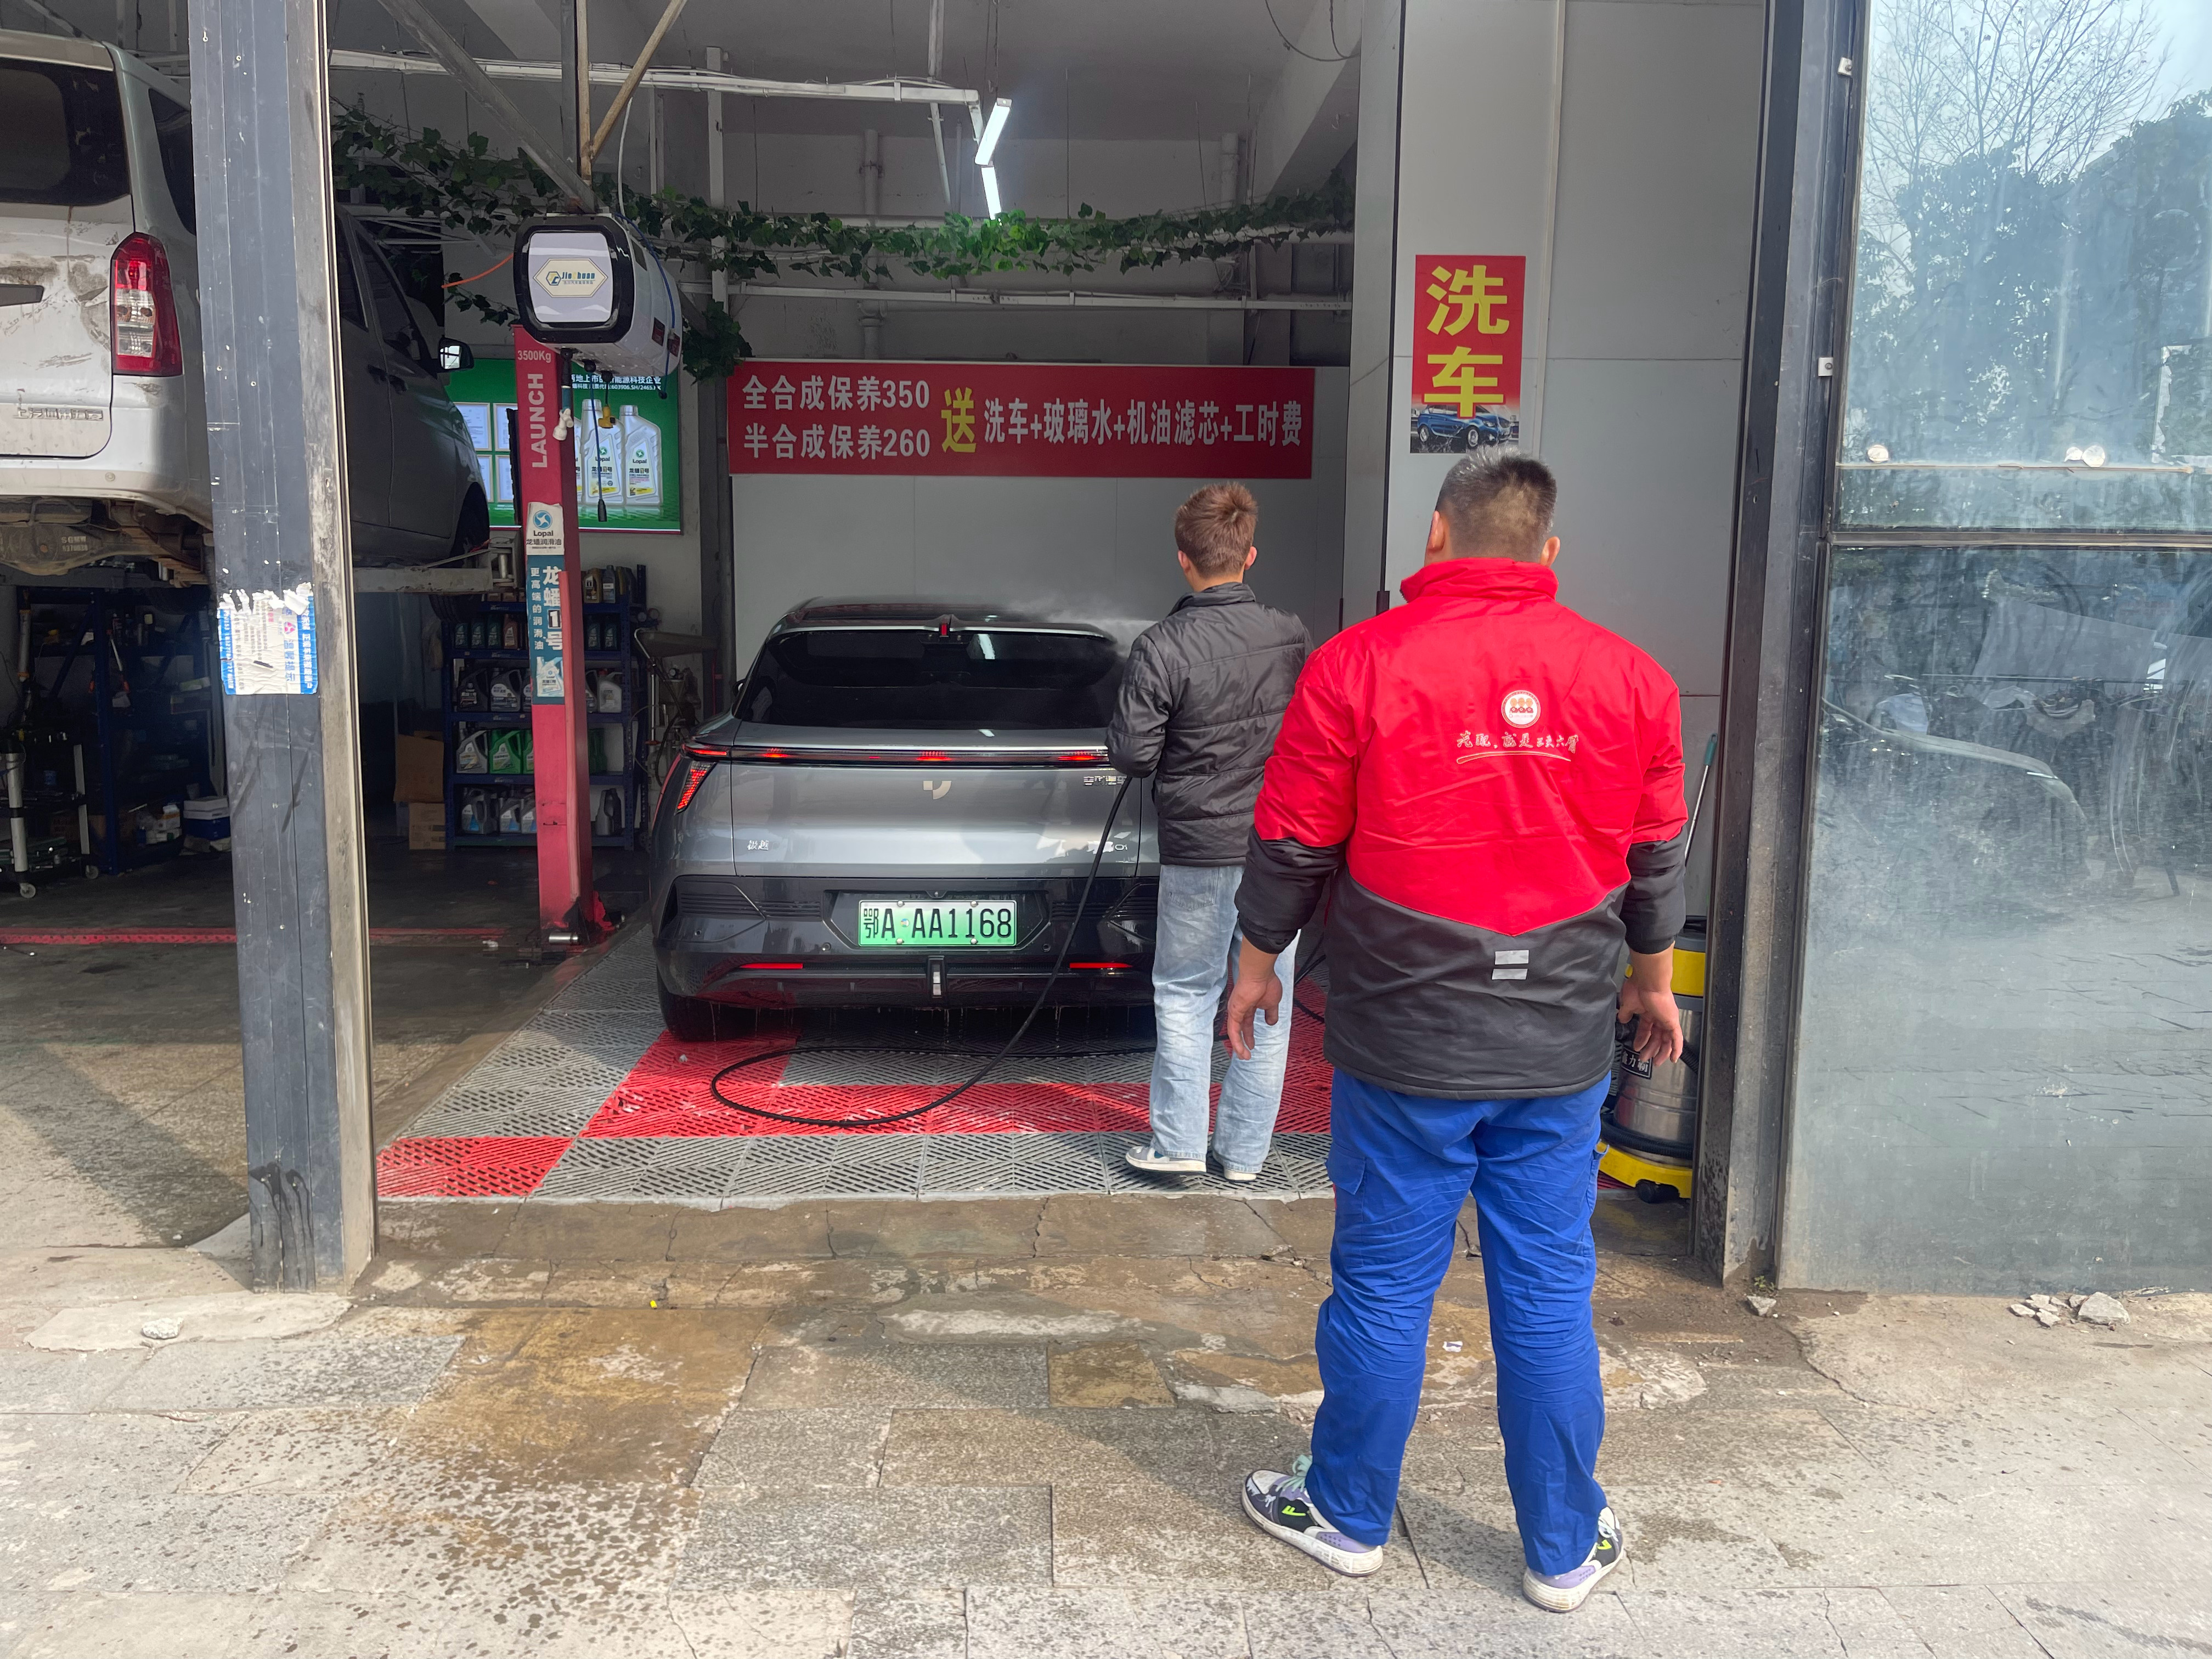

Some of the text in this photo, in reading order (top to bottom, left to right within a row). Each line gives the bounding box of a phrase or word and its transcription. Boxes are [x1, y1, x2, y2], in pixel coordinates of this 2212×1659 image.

[517, 350, 551, 363] 3500Kg
[1424, 265, 1509, 417] 洗车
[528, 374, 548, 468] LAUNCH
[742, 375, 930, 412] 全合成保养350
[940, 386, 1302, 454] 送 洗车+玻璃水+机油滤芯+工时费
[743, 422, 931, 461] 半合成保养260
[530, 567, 544, 650] 更高端的润滑油
[543, 566, 563, 651] 龙蟠1号
[284, 639, 295, 681] 温馨提示
